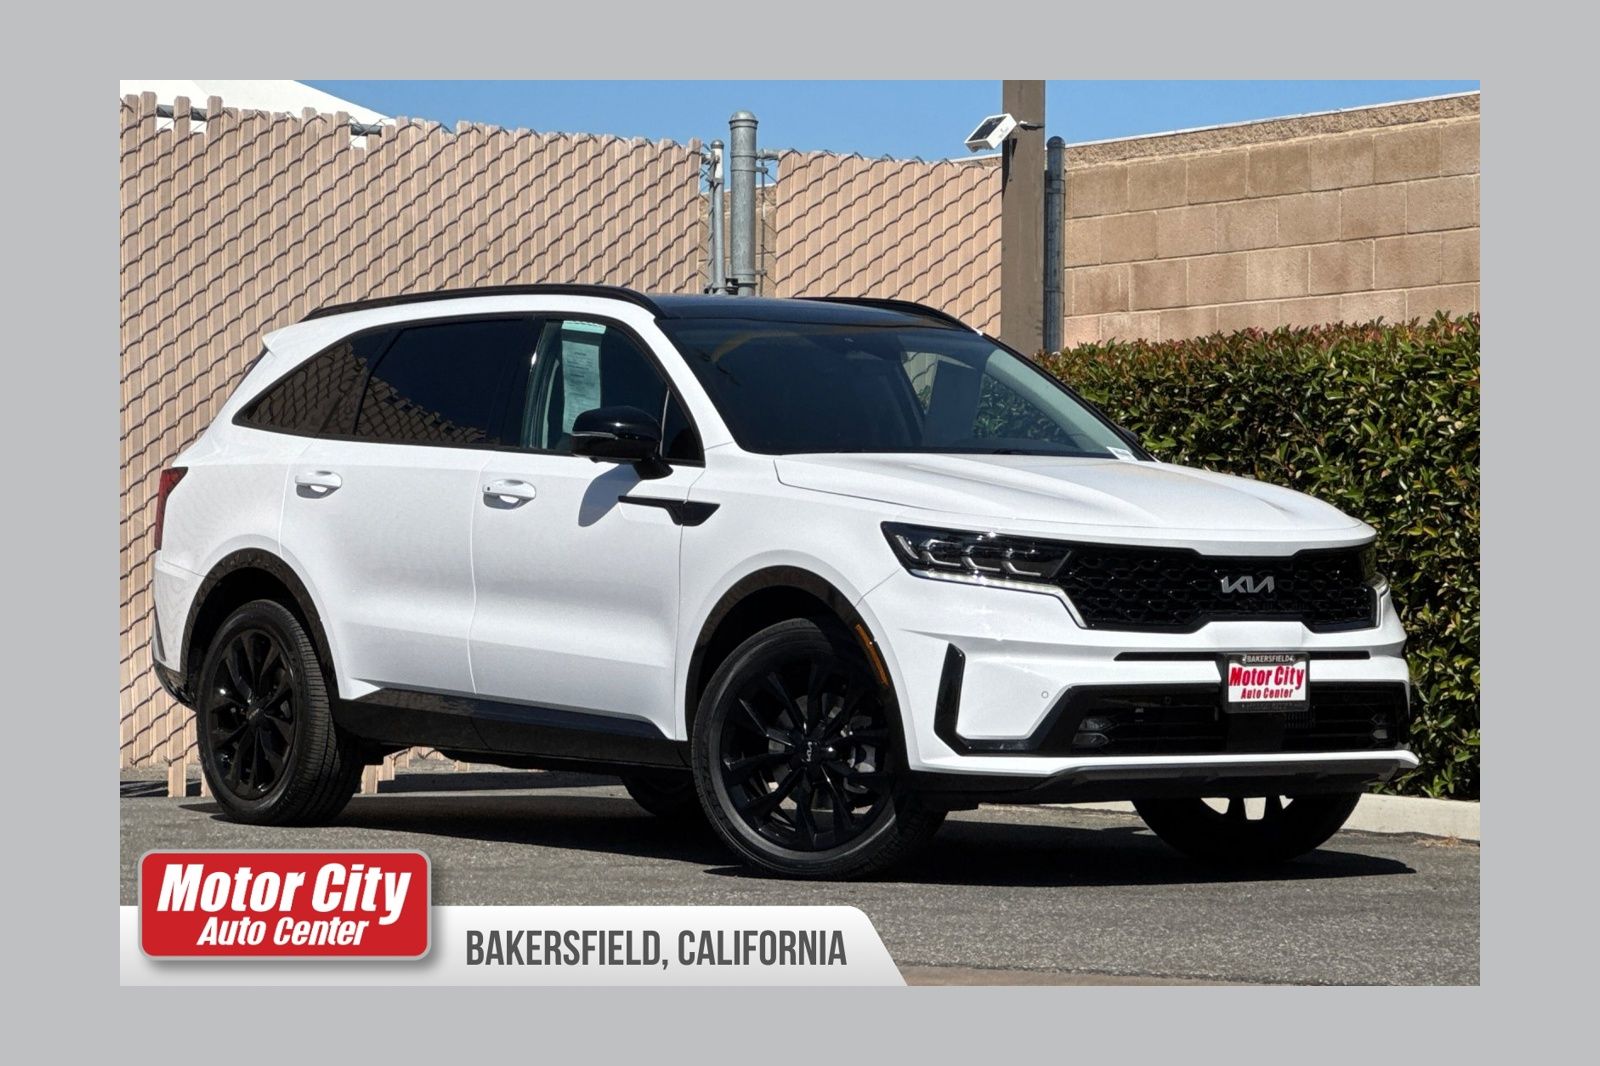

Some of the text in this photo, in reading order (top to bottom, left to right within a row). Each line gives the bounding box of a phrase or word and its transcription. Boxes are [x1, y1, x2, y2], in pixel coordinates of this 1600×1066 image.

[1221, 575, 1275, 594] KIA
[1246, 654, 1290, 663] BAKERSFIELD
[1229, 665, 1305, 690] Motor City
[1241, 687, 1294, 699] Auto Center
